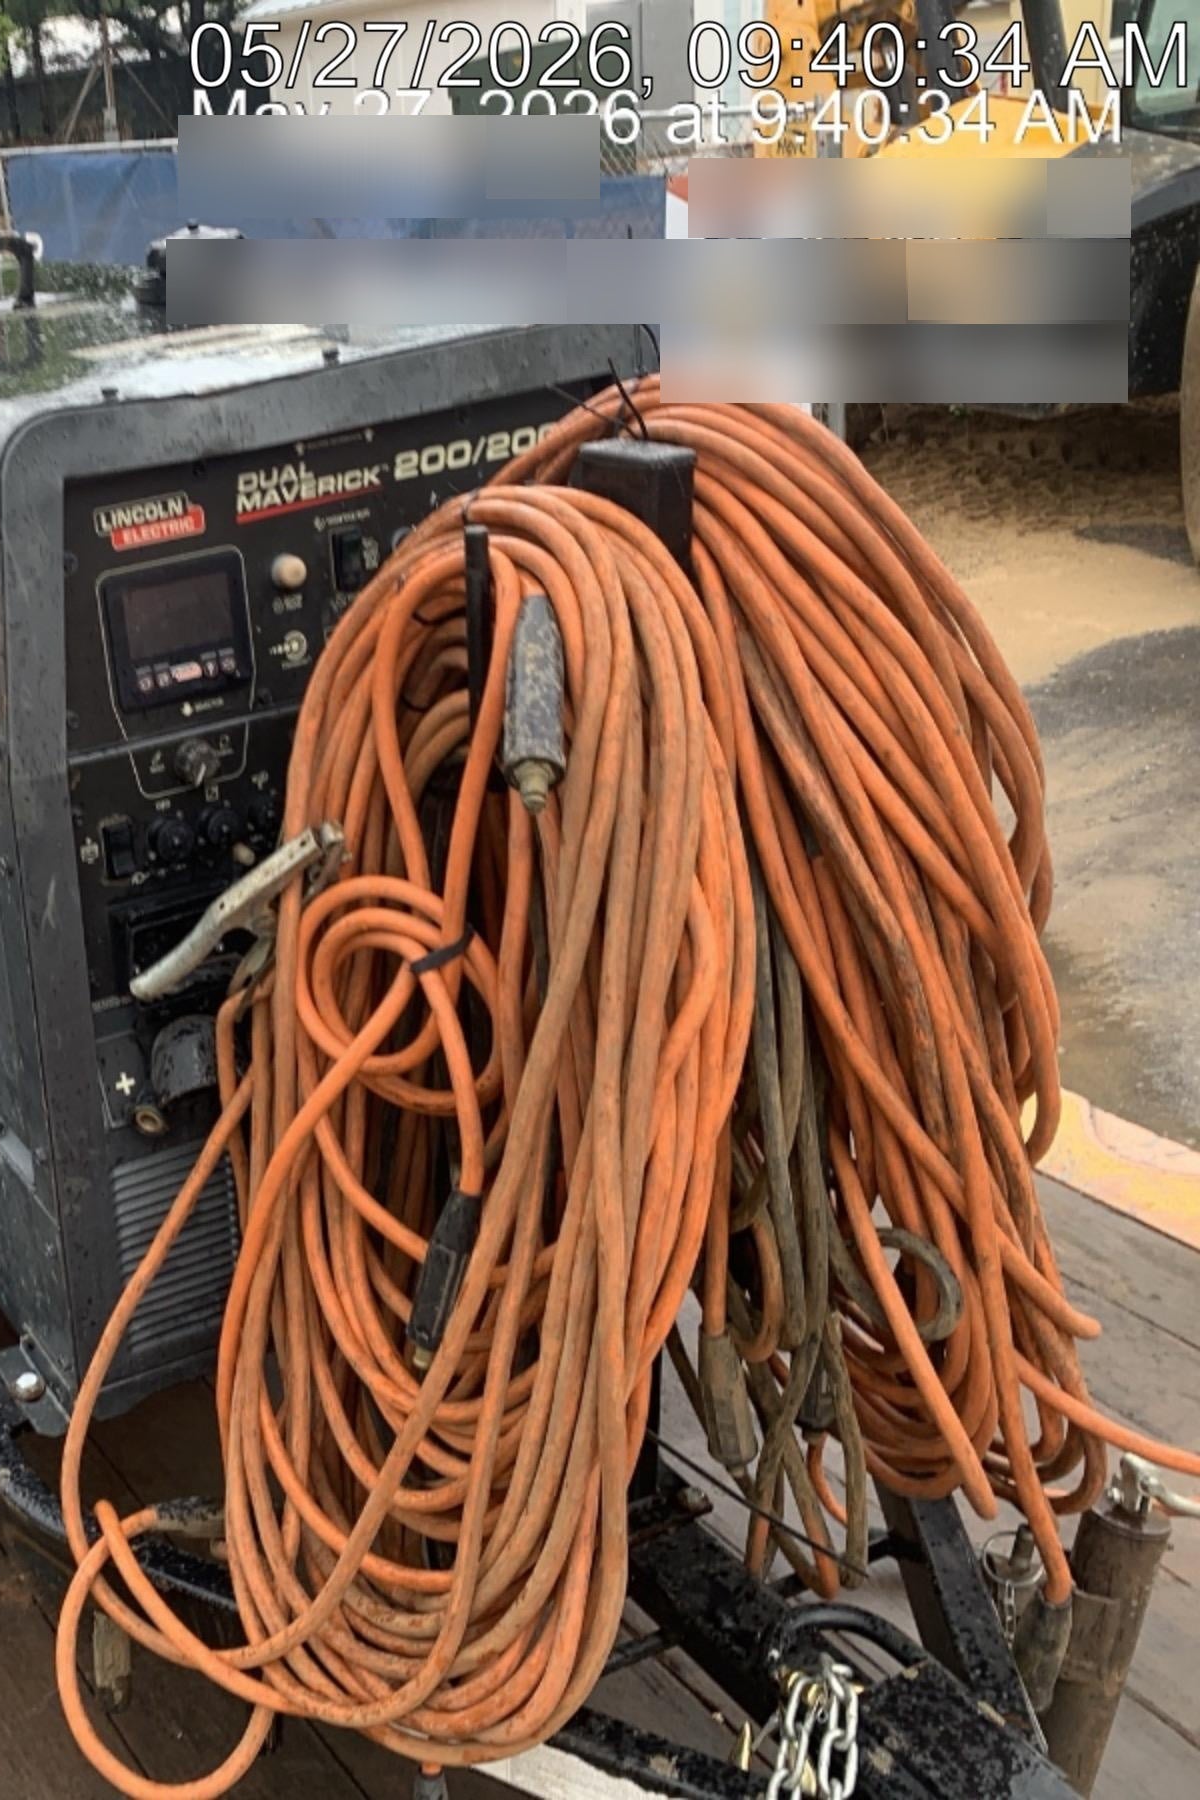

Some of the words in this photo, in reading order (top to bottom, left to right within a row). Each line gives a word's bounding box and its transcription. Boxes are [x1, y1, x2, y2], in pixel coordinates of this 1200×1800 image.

[238, 461, 314, 492] DUAL
[101, 496, 184, 532] LINCOLN
[122, 516, 194, 546] ELECTRIC
